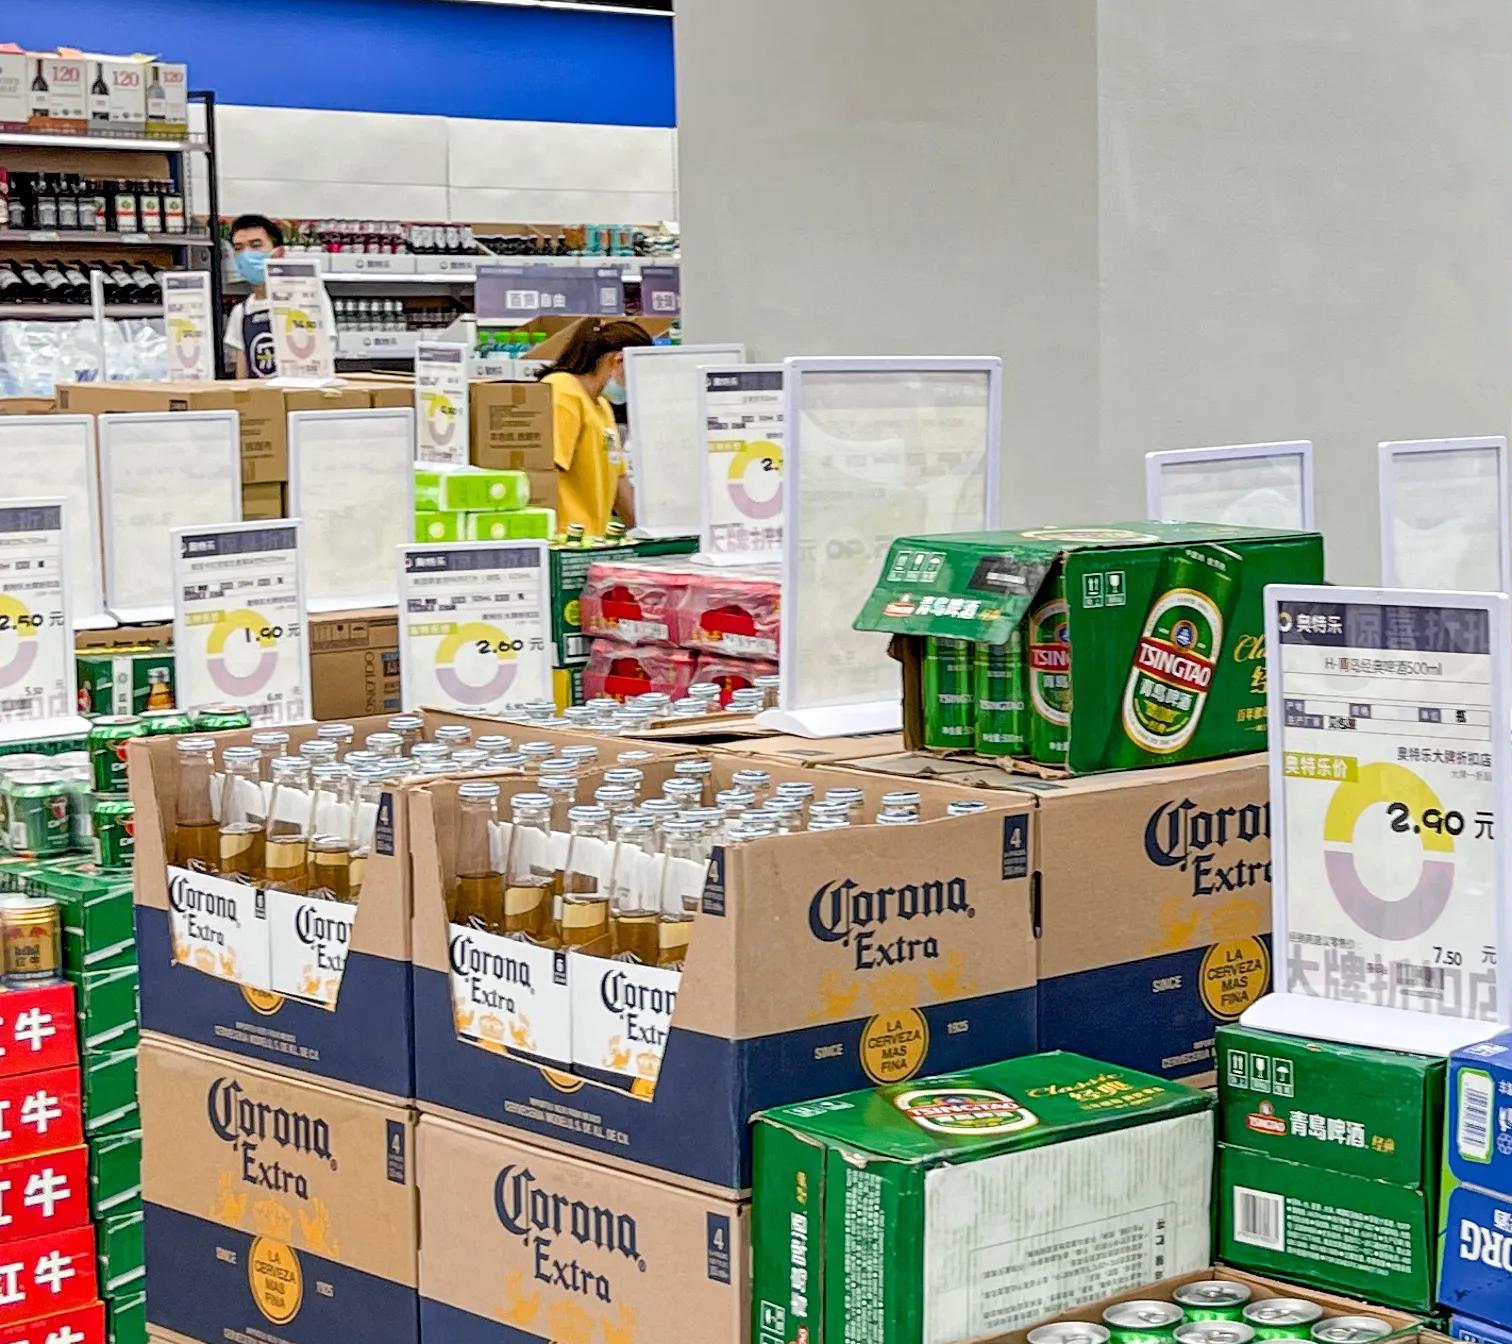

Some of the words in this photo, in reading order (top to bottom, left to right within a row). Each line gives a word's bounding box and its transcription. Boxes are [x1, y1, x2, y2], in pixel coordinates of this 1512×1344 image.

[52, 66, 80, 82] 120
[112, 71, 139, 86] 120
[244, 627, 283, 643] 1.90
[1296, 615, 1342, 635] 奥特乐
[1139, 642, 1213, 687] TSINGTAO
[1386, 802, 1465, 836] 2.90
[1475, 811, 1495, 840] 元
[1009, 826, 1022, 850] 4
[168, 874, 237, 923] Corona
[808, 873, 969, 945] Corona
[187, 915, 224, 946] Extra
[449, 934, 531, 988] Corona
[855, 934, 939, 971] Extra
[1226, 948, 1244, 963] LA
[1433, 947, 1463, 967] 7.50
[470, 978, 515, 1014] Extra
[1221, 976, 1249, 992] MAS
[1220, 990, 1250, 1007] FINA
[886, 1019, 903, 1033] LA
[868, 1029, 922, 1049] CERVEZA
[882, 1046, 907, 1059] MAS
[881, 1058, 908, 1074] FINA
[208, 1076, 333, 1159] Corona
[1290, 1111, 1366, 1149] 青岛啤酒
[240, 1140, 309, 1201] Extra
[495, 1163, 640, 1258] Corona
[712, 1227, 725, 1251] 4
[533, 1236, 612, 1303] Extra
